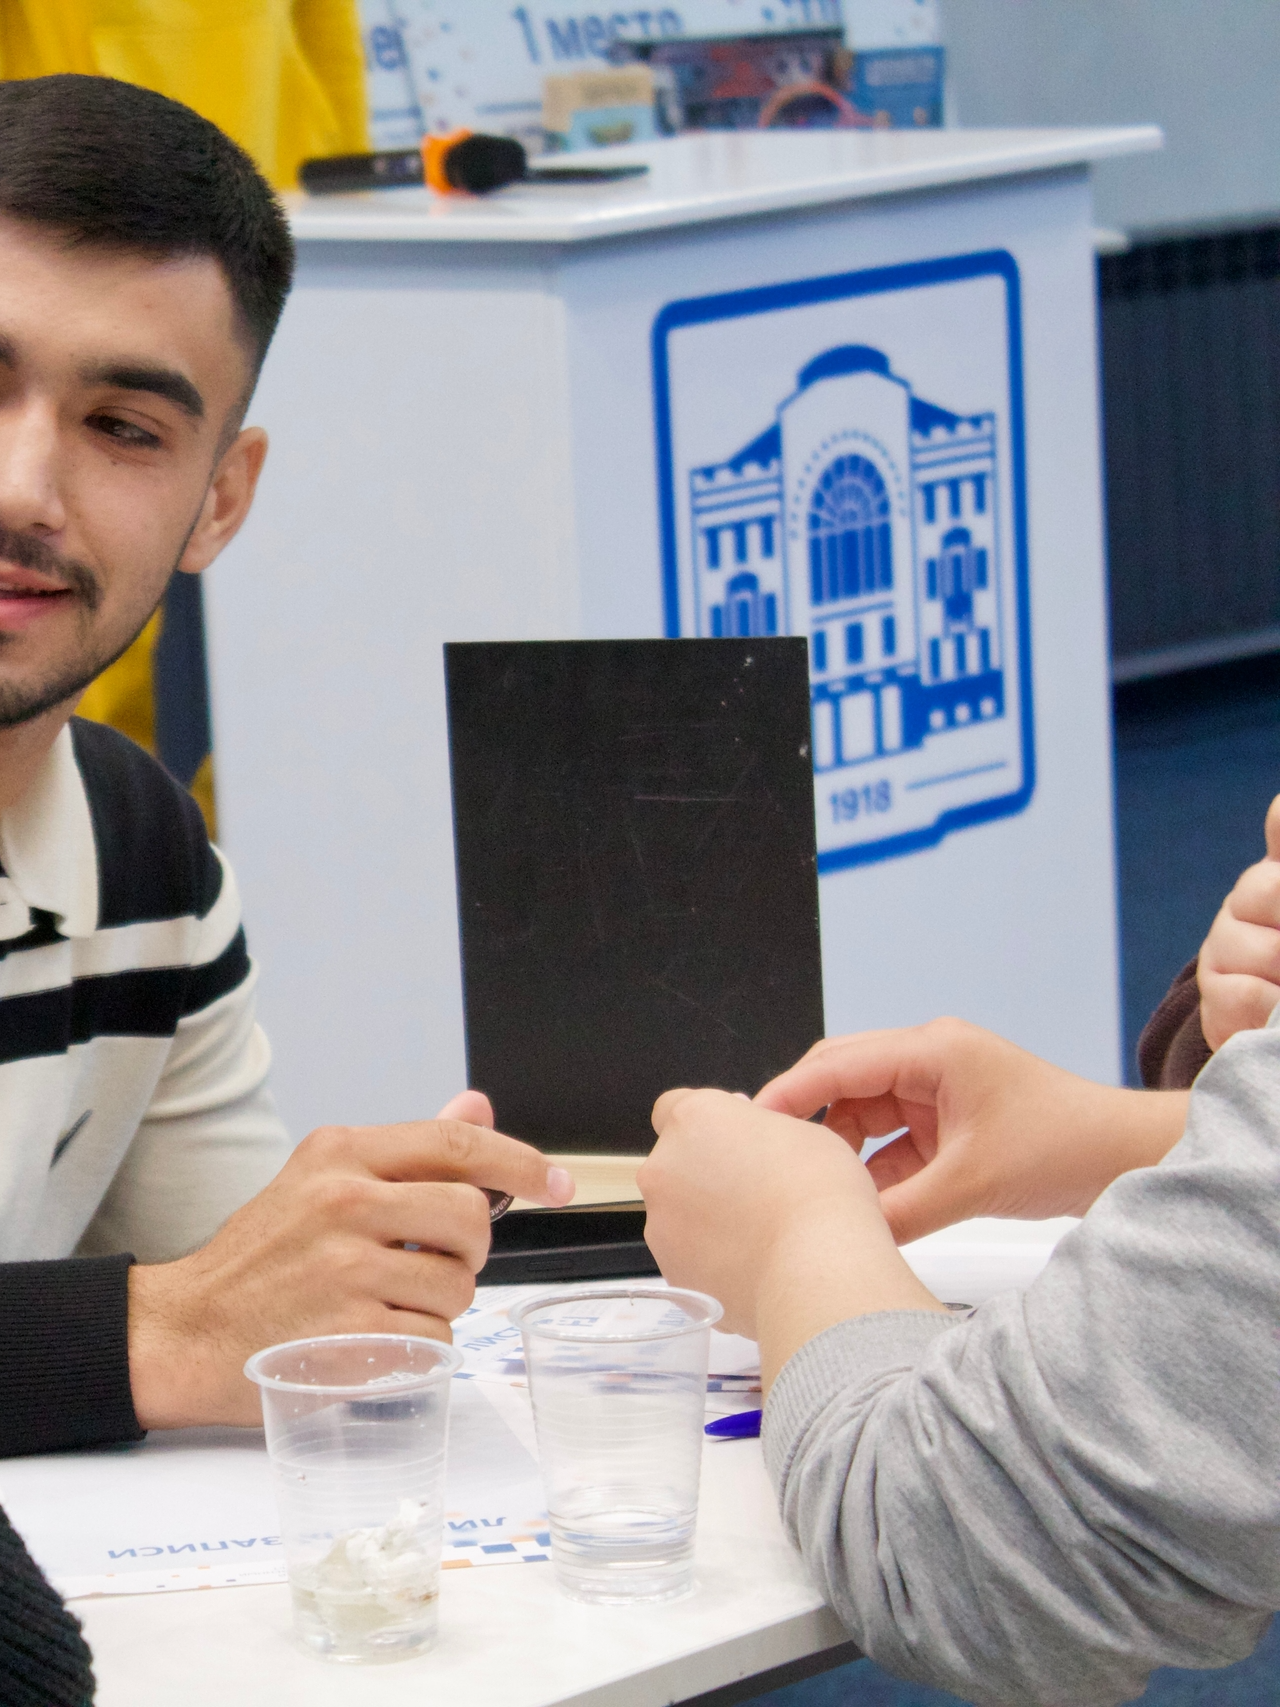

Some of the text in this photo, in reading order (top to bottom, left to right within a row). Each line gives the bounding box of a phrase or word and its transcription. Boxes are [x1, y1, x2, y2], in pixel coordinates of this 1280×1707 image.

[512, 5, 541, 66] 1
[830, 779, 891, 824] 1918
[442, 1516, 507, 1531] ЛИ
[107, 1535, 283, 1559] ЗАПИСИ
